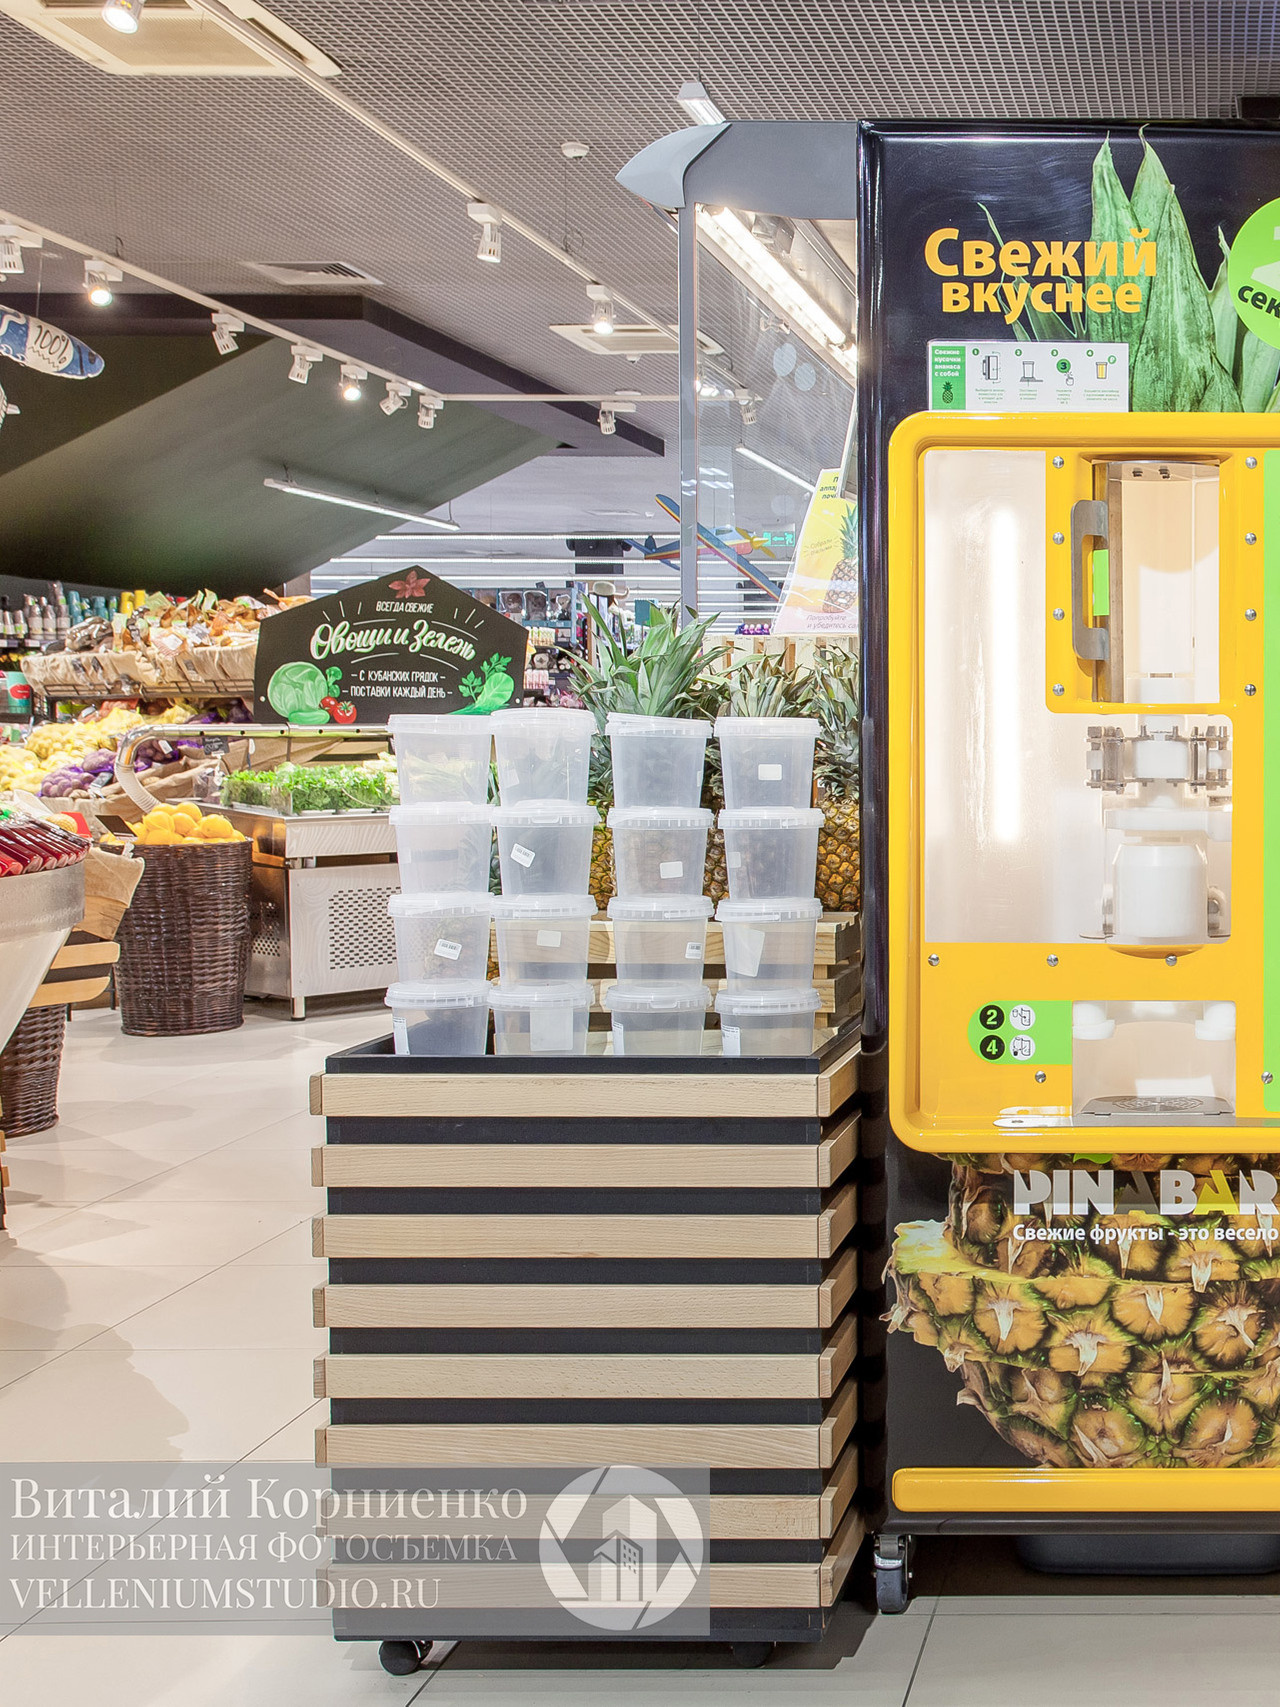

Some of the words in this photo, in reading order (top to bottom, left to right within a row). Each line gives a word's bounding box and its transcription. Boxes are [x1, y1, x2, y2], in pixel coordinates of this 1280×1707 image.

[924, 227, 1158, 278] Свежий
[941, 281, 1143, 326] вкуснее
[34, 324, 70, 364] 100%
[376, 600, 405, 613] ВСЕГДА
[405, 601, 434, 614] СВЕЖИЕ
[310, 621, 392, 660] Овощи
[393, 630, 409, 645] и
[408, 619, 477, 661] Зелень
[359, 671, 365, 683] С
[368, 670, 410, 683] КУБАНСКИХ
[411, 671, 439, 684] ГРЯДОК
[350, 685, 391, 698] ПОСТАВКИ
[392, 684, 427, 699] КАЖДЫЙ
[427, 686, 446, 699] ДЕНЬ
[986, 1009, 998, 1025] 2
[985, 1040, 998, 1056] 4
[1013, 1223, 1085, 1241] Свежие
[1090, 1223, 1164, 1245] фрукты
[1178, 1226, 1212, 1241] это
[1214, 1226, 1279, 1241] весело
